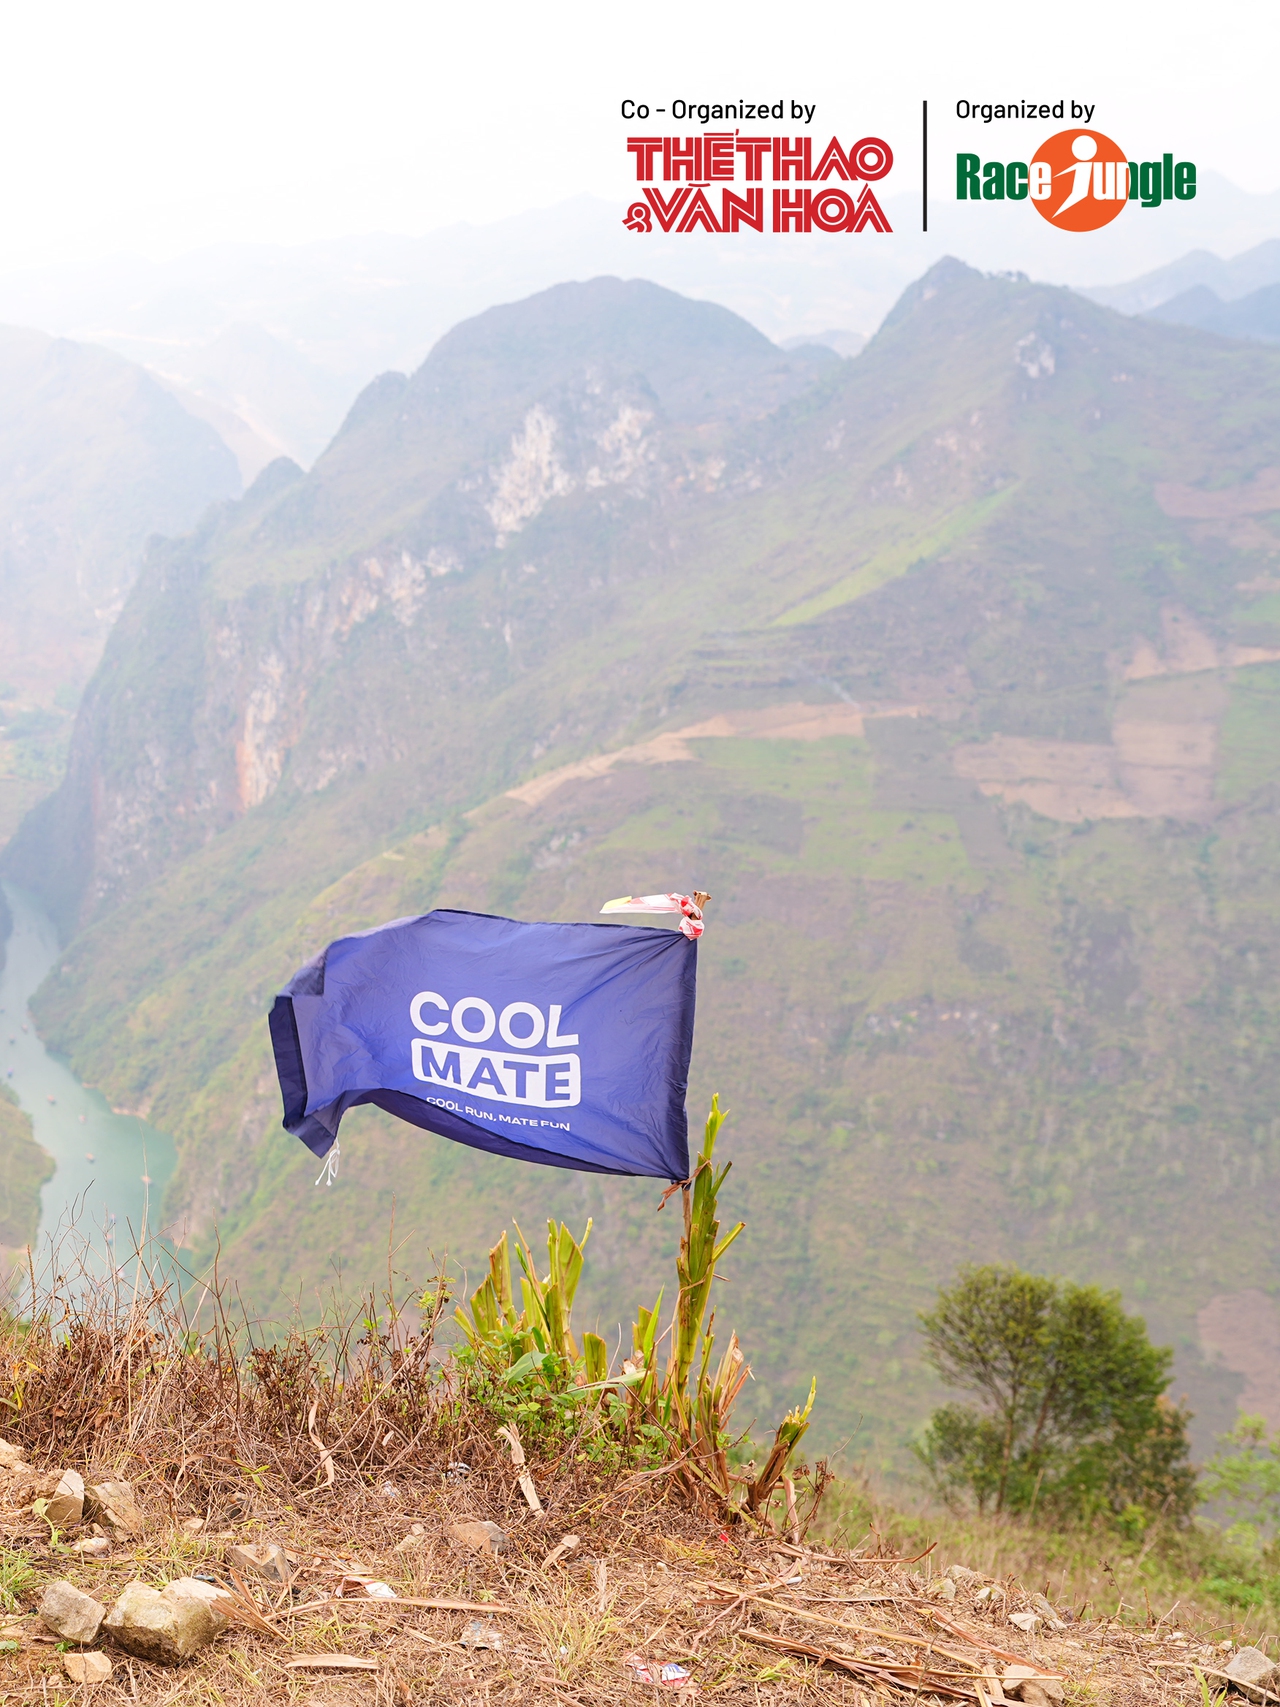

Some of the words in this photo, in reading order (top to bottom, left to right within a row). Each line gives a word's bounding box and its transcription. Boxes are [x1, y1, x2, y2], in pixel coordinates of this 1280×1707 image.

[410, 991, 579, 1049] COOL
[421, 1045, 571, 1101] MATE
[426, 1096, 464, 1113] COOL
[465, 1106, 497, 1122] RUN,
[498, 1114, 539, 1127] MATE
[540, 1120, 570, 1132] FUN
